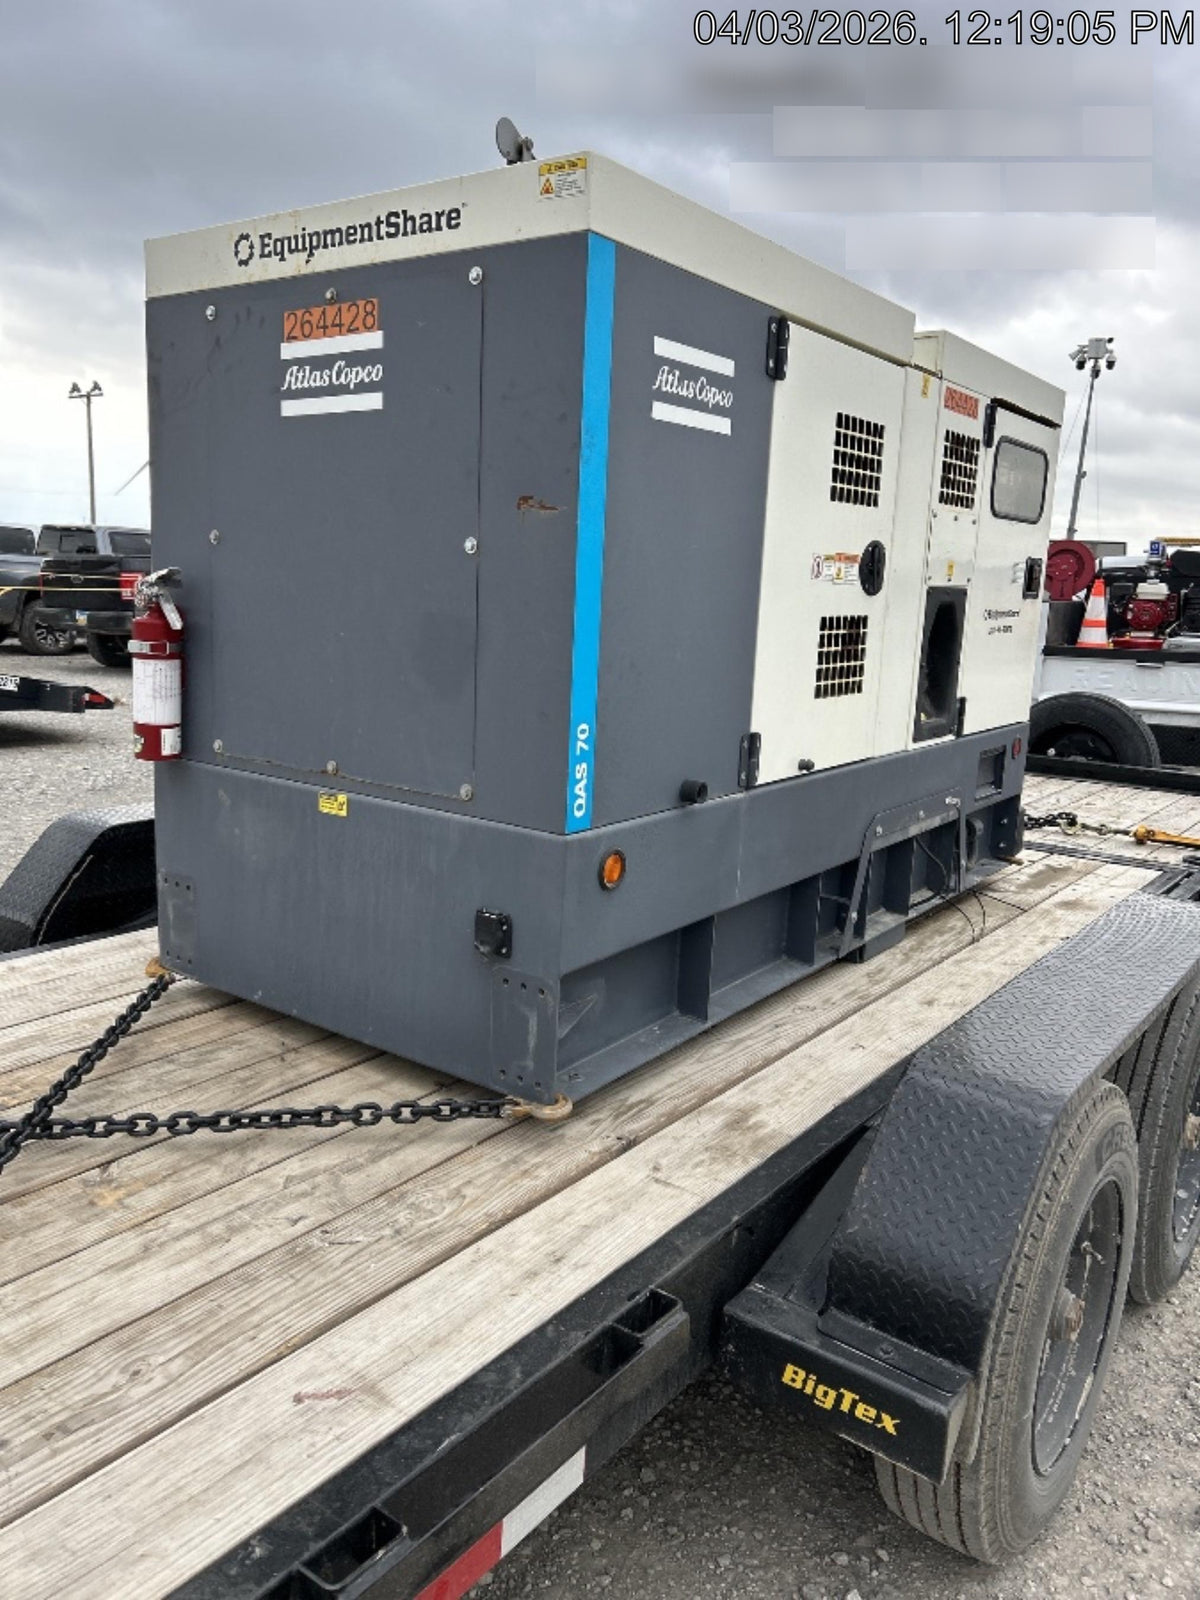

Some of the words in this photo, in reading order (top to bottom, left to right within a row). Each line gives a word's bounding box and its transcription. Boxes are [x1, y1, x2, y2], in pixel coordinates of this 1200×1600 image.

[258, 206, 463, 262] EquipmentShare
[285, 299, 377, 341] 264428
[576, 722, 590, 756] 70
[573, 762, 588, 819] QAS
[780, 1362, 901, 1437] BigTex
